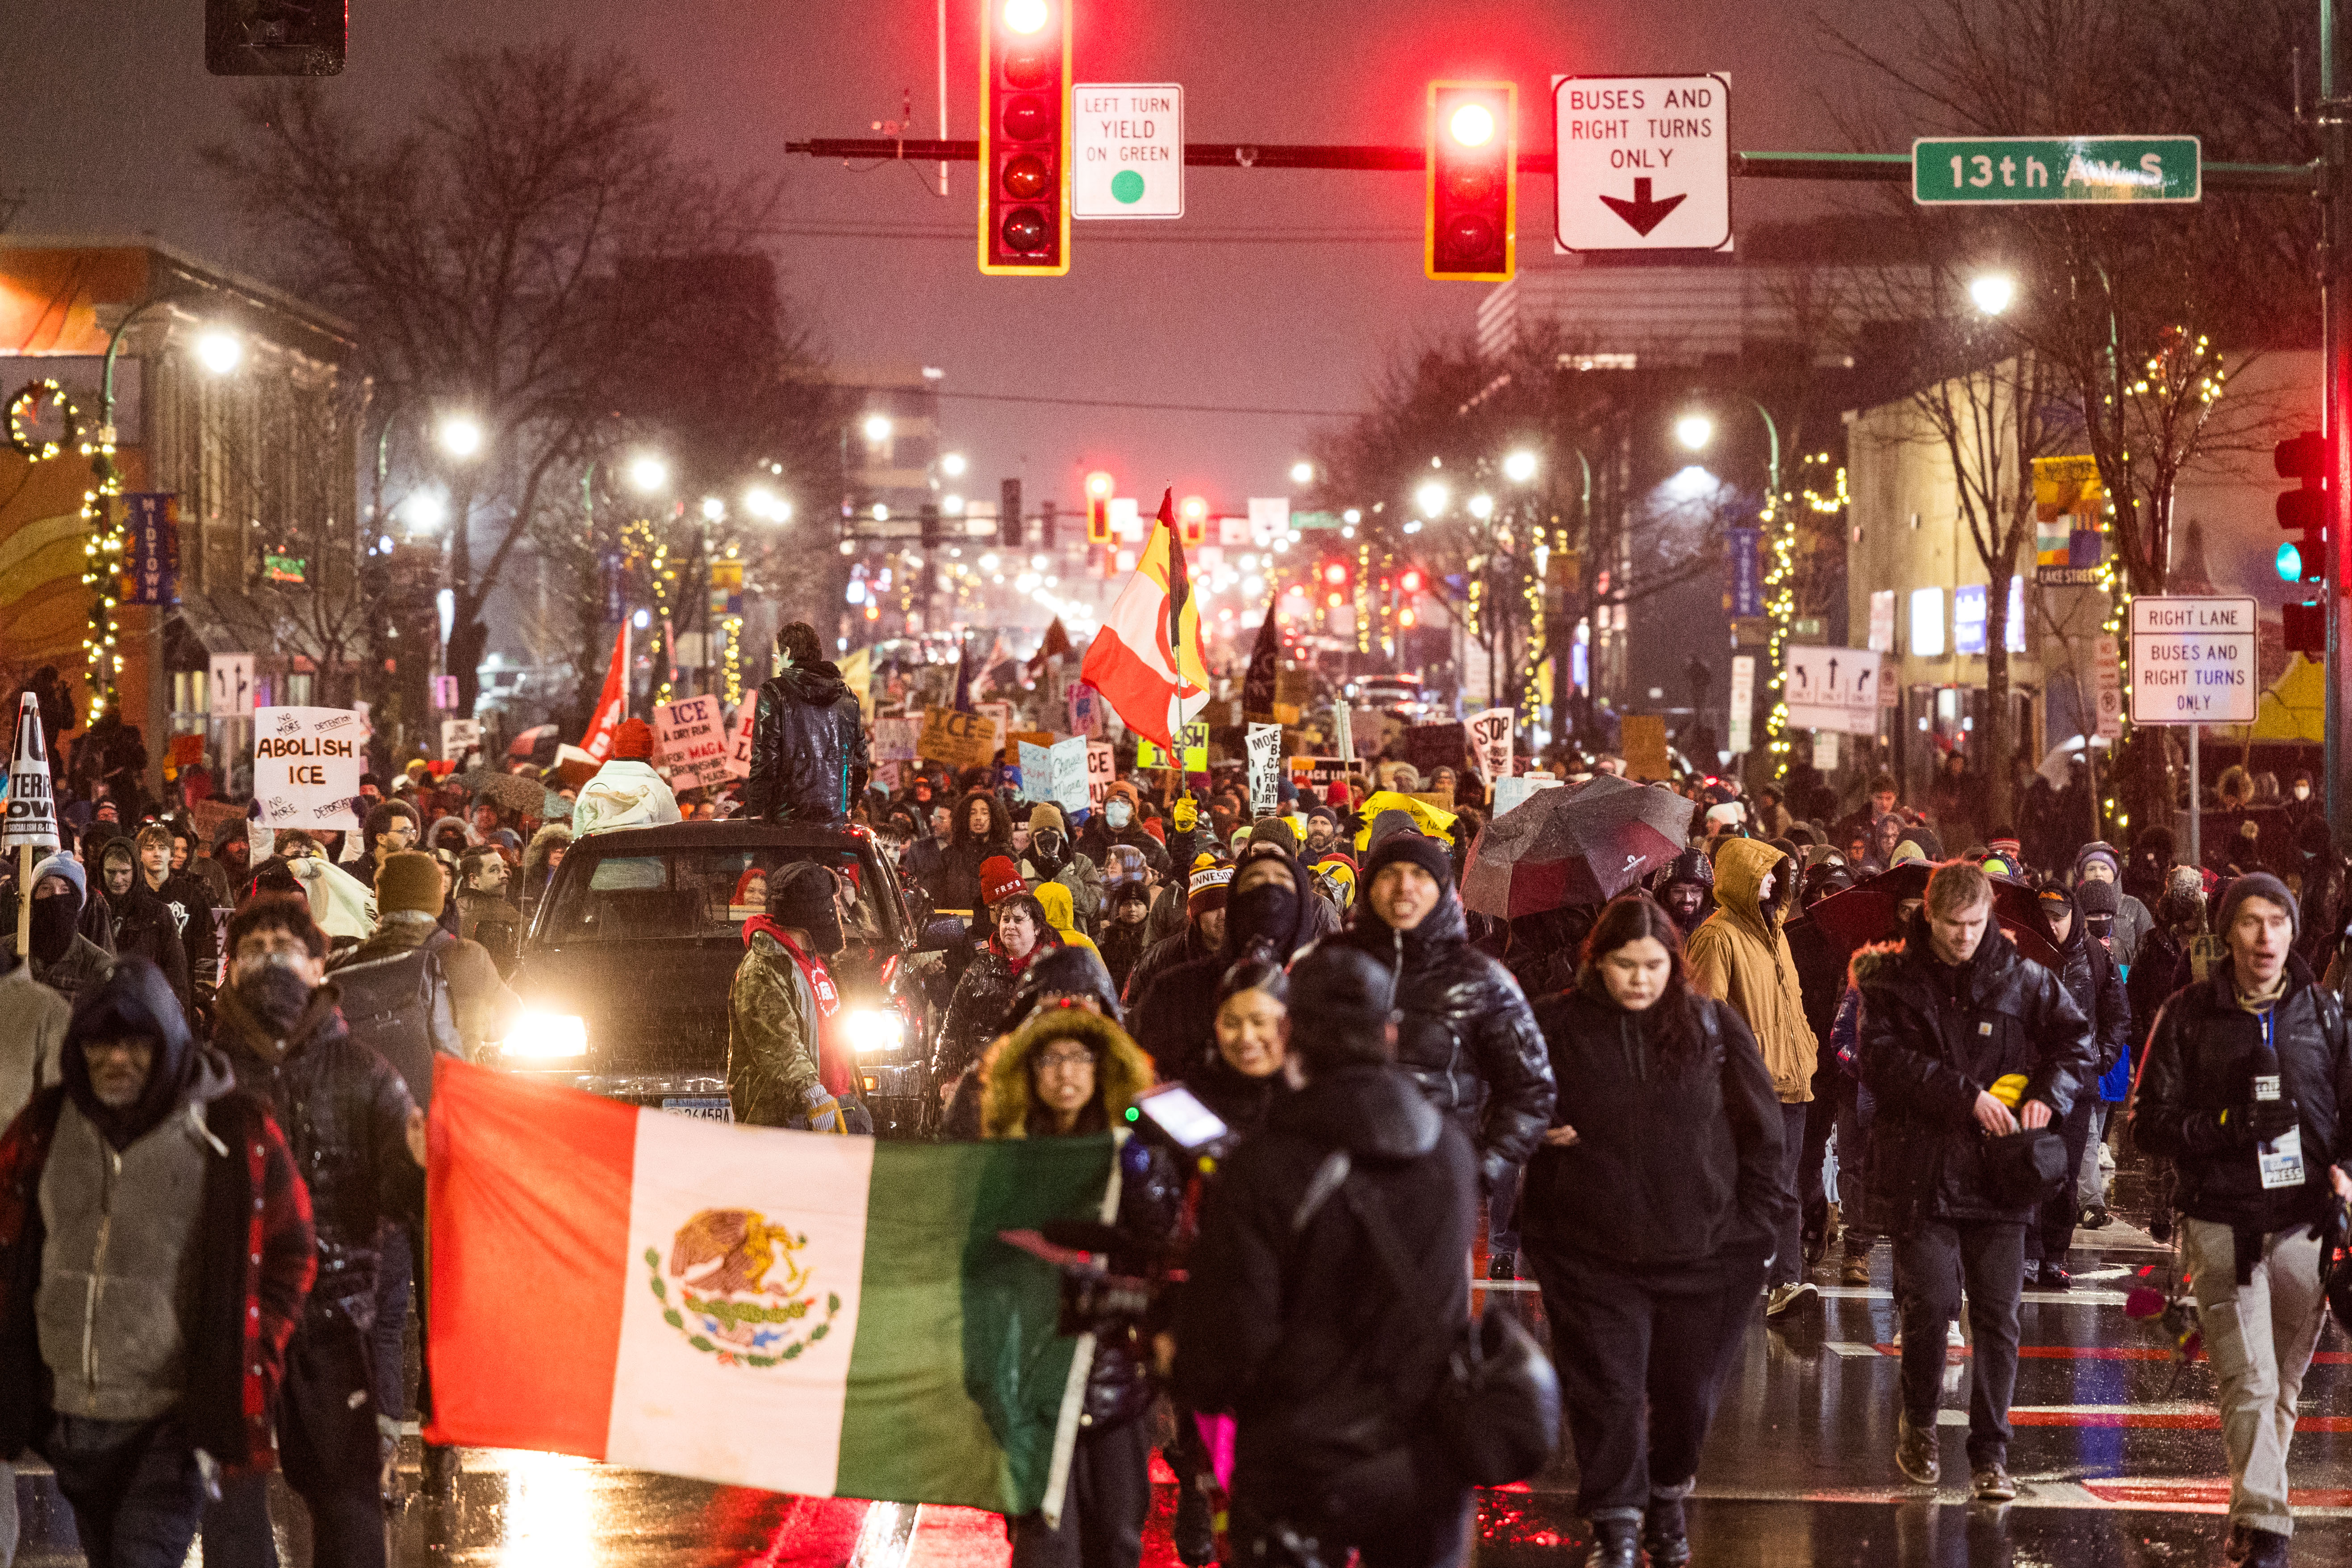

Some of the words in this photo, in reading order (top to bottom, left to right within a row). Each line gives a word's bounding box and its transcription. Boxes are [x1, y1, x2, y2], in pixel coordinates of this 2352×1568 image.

[1085, 98, 1119, 113] LEFT
[1132, 98, 1170, 113] TURN
[1571, 90, 1645, 110] BUSES
[1664, 88, 1712, 109] AND
[1101, 120, 1156, 138] YIELD
[1572, 119, 1629, 140] RIGHT
[1648, 118, 1712, 138] TURNS
[1087, 146, 1107, 161] ON
[1120, 146, 1170, 161] GREEN
[1610, 148, 1673, 168] ONLY
[1950, 155, 2048, 188] 13th
[2139, 153, 2162, 186] S
[2149, 610, 2193, 626] RIGHT
[2200, 610, 2239, 625] LANE
[2151, 644, 2201, 661] BUSES
[2206, 644, 2238, 660] AND
[2144, 670, 2188, 686] RIGHT
[2195, 669, 2245, 685] TURNS
[669, 700, 708, 724] ICE
[2177, 695, 2211, 711] ONLY
[277, 713, 291, 723] NO
[314, 714, 352, 732] DETENTION
[930, 707, 978, 738] ICE
[276, 720, 301, 735] MORE
[664, 730, 670, 742] A
[673, 728, 689, 740] DRY
[691, 723, 711, 736] RUN
[1474, 716, 1509, 745] STOP
[257, 737, 352, 758] ABOLISH
[667, 751, 685, 762] FOR
[689, 740, 726, 759] MAGA
[1087, 751, 1109, 773] CE
[289, 765, 326, 785] ICE
[268, 796, 282, 809] NO
[271, 803, 297, 821] MORE
[9, 823, 36, 832] SOCIALISM
[38, 824, 45, 832] &
[995, 879, 1021, 895] FRSO
[1190, 871, 1233, 888] INNESOT
